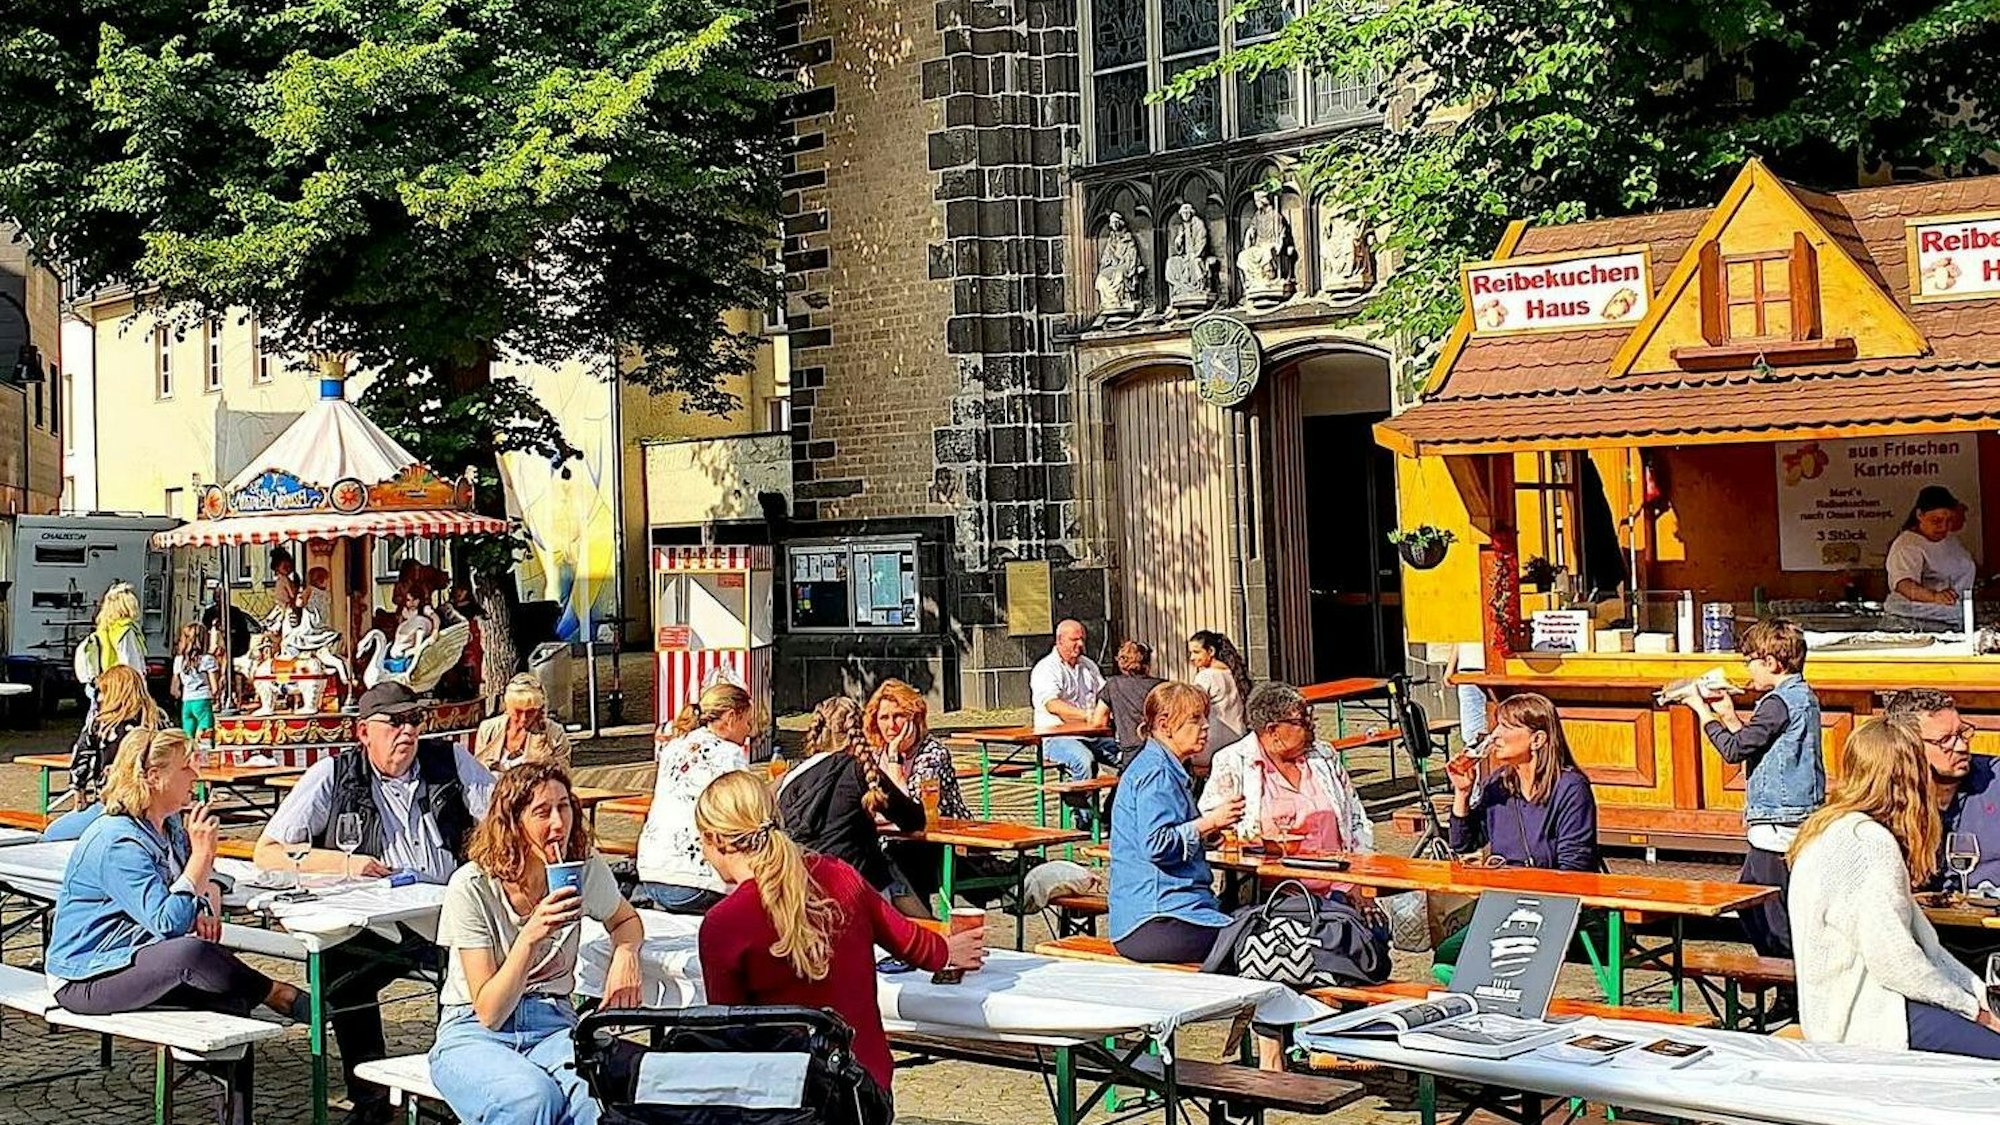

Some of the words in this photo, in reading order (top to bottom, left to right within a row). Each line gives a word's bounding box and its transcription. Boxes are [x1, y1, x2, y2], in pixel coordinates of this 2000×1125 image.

[1472, 264, 1640, 295] Reibekuchen
[1526, 299, 1591, 320] Haus
[1848, 446, 1878, 459] aus
[1884, 440, 1960, 457] Frischen
[1854, 460, 1939, 478] Kartoffeln
[1816, 530, 1825, 541] 3
[1828, 529, 1868, 541] Stück
